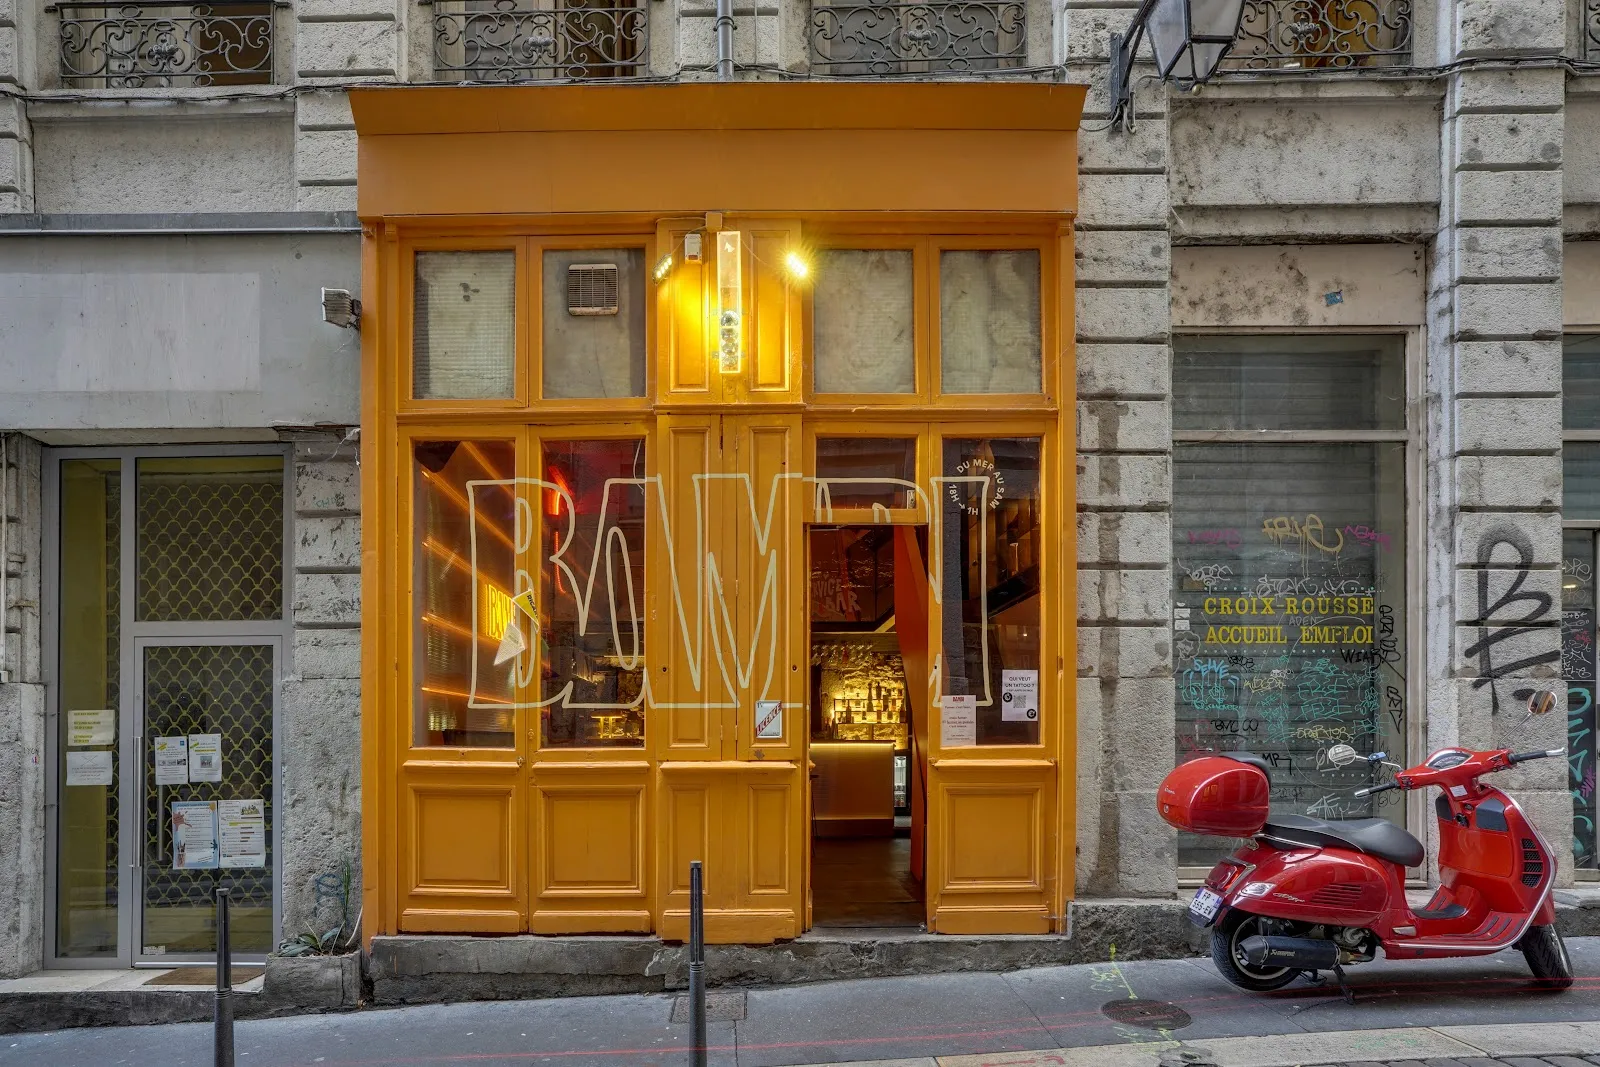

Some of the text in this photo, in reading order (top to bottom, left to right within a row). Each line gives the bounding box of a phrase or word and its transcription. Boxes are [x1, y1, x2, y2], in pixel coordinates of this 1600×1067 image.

[948, 484, 979, 516] 18H 1H
[956, 458, 1005, 510] DU MER AU SAM
[1204, 597, 1374, 615] CROIX-ROUSSE
[1205, 625, 1374, 644] ACCUEIL EMPLOI
[756, 701, 782, 736] LICENCE
